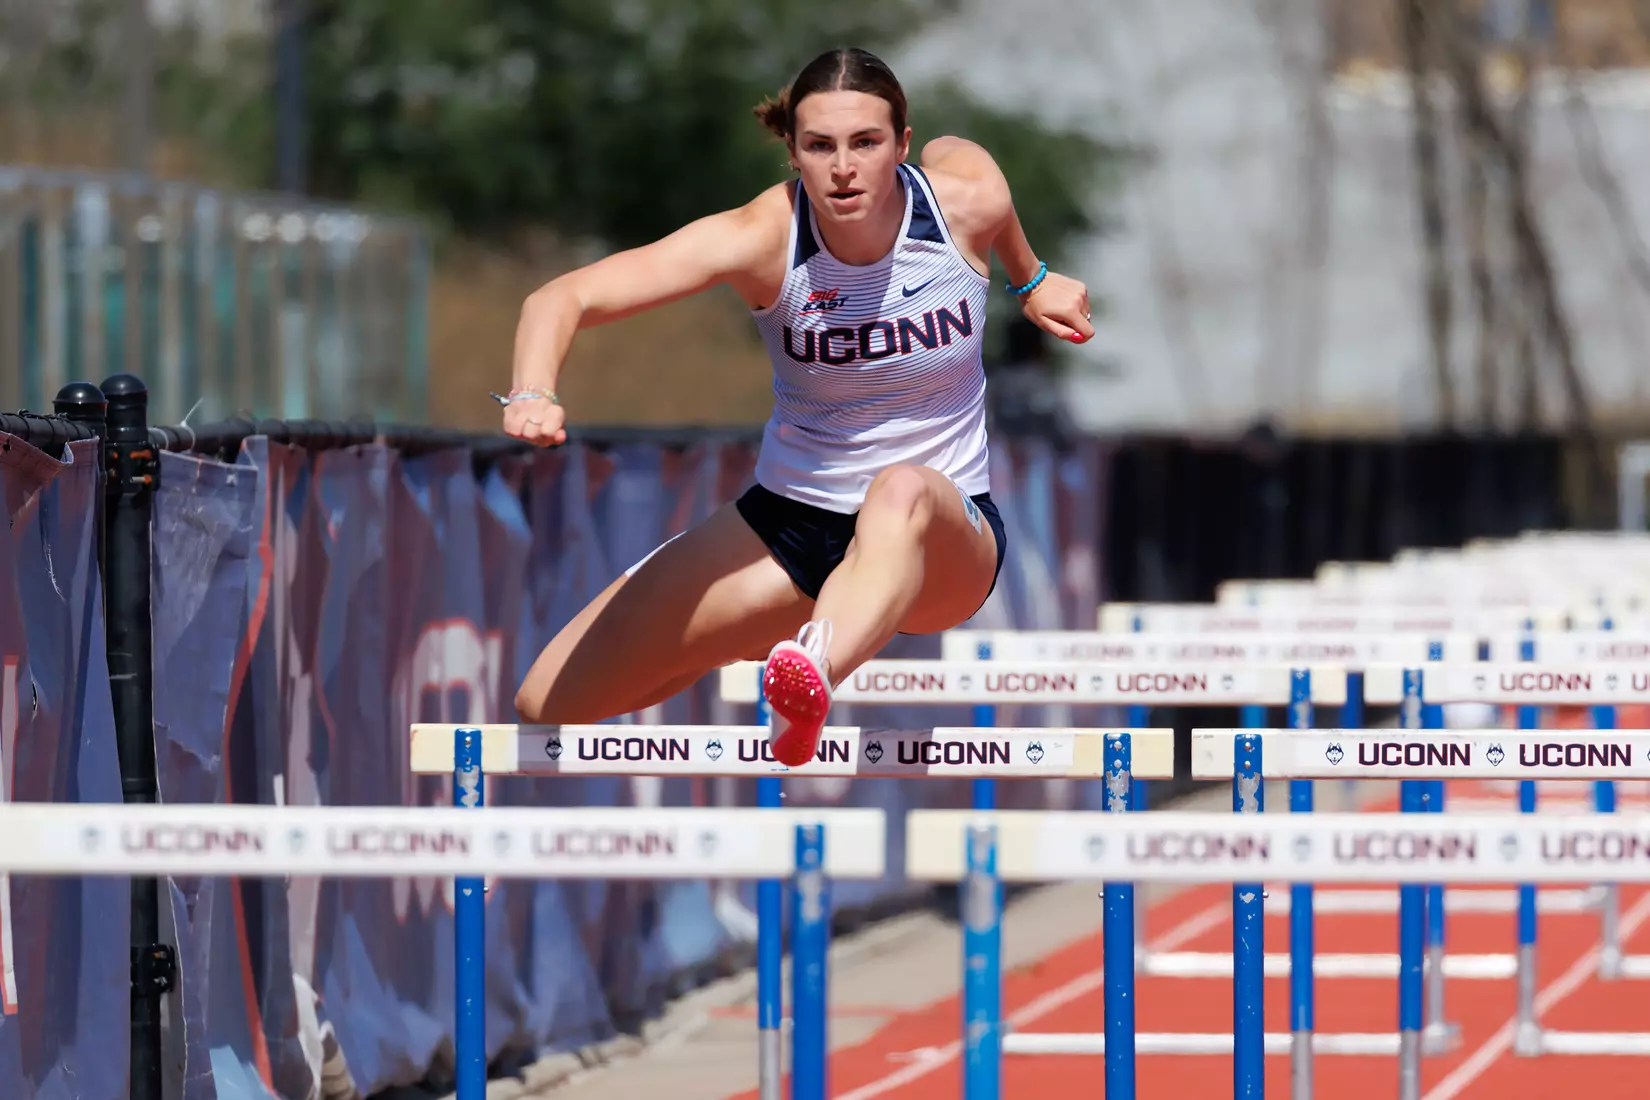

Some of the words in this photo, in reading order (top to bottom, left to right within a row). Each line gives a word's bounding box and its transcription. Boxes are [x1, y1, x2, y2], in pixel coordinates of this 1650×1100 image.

[801, 297, 849, 312] EAST
[783, 298, 973, 365] UCONN
[854, 673, 945, 693] UCONN
[985, 673, 1076, 693] UCONN
[1116, 673, 1207, 693] UCONN
[1500, 673, 1591, 692] UCONN
[578, 737, 690, 762] UCONN
[738, 738, 850, 763] UCNN
[897, 740, 1010, 765] UCONN
[1358, 743, 1471, 767] UCONN
[1519, 743, 1632, 768] UCONN
[122, 826, 264, 854] UCONN
[328, 826, 470, 854] UCONN
[533, 827, 676, 855] UCONN
[1127, 831, 1270, 861] UCONN
[1333, 831, 1477, 861] UCONN
